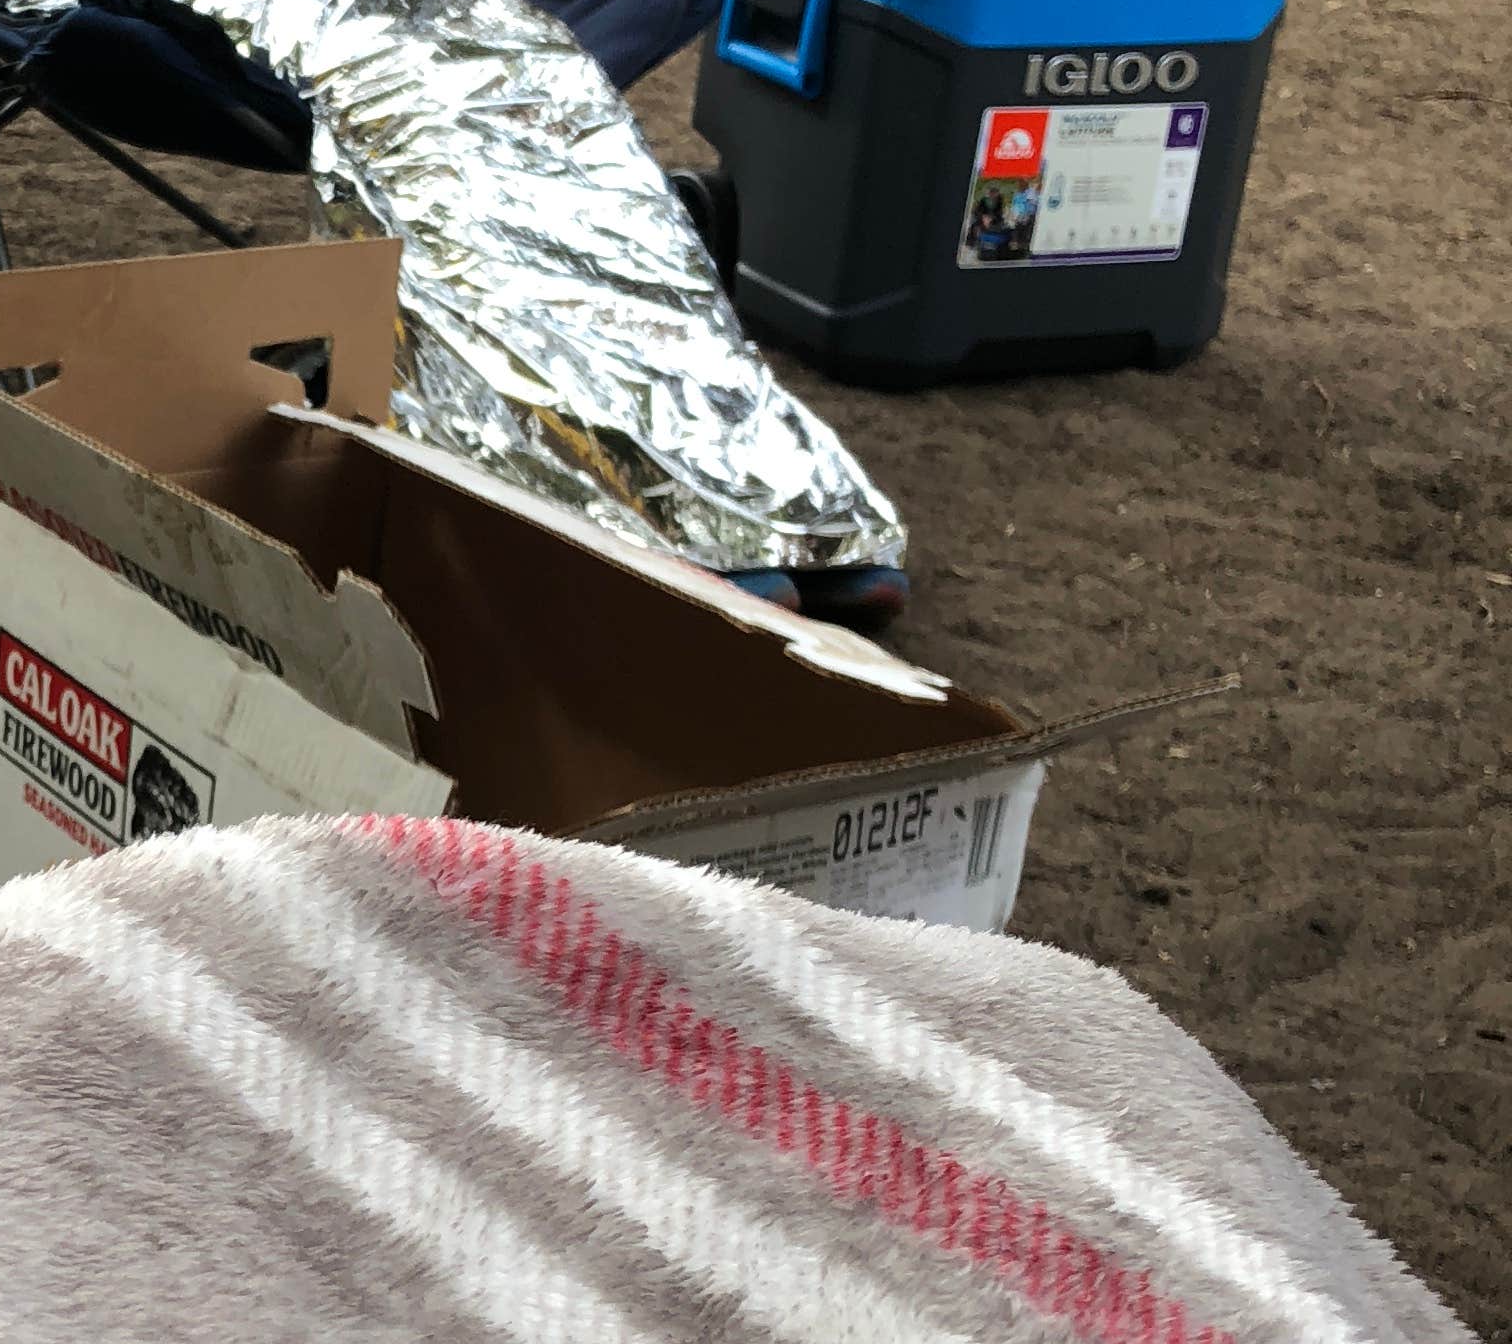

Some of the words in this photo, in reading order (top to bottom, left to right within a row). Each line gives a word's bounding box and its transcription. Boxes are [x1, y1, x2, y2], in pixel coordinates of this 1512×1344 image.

[1024, 50, 1199, 96] IGLOO
[6, 651, 58, 725] CAL
[60, 687, 124, 770] OAK
[3, 710, 116, 822] FIREWOOD
[832, 787, 939, 862] 01212F
